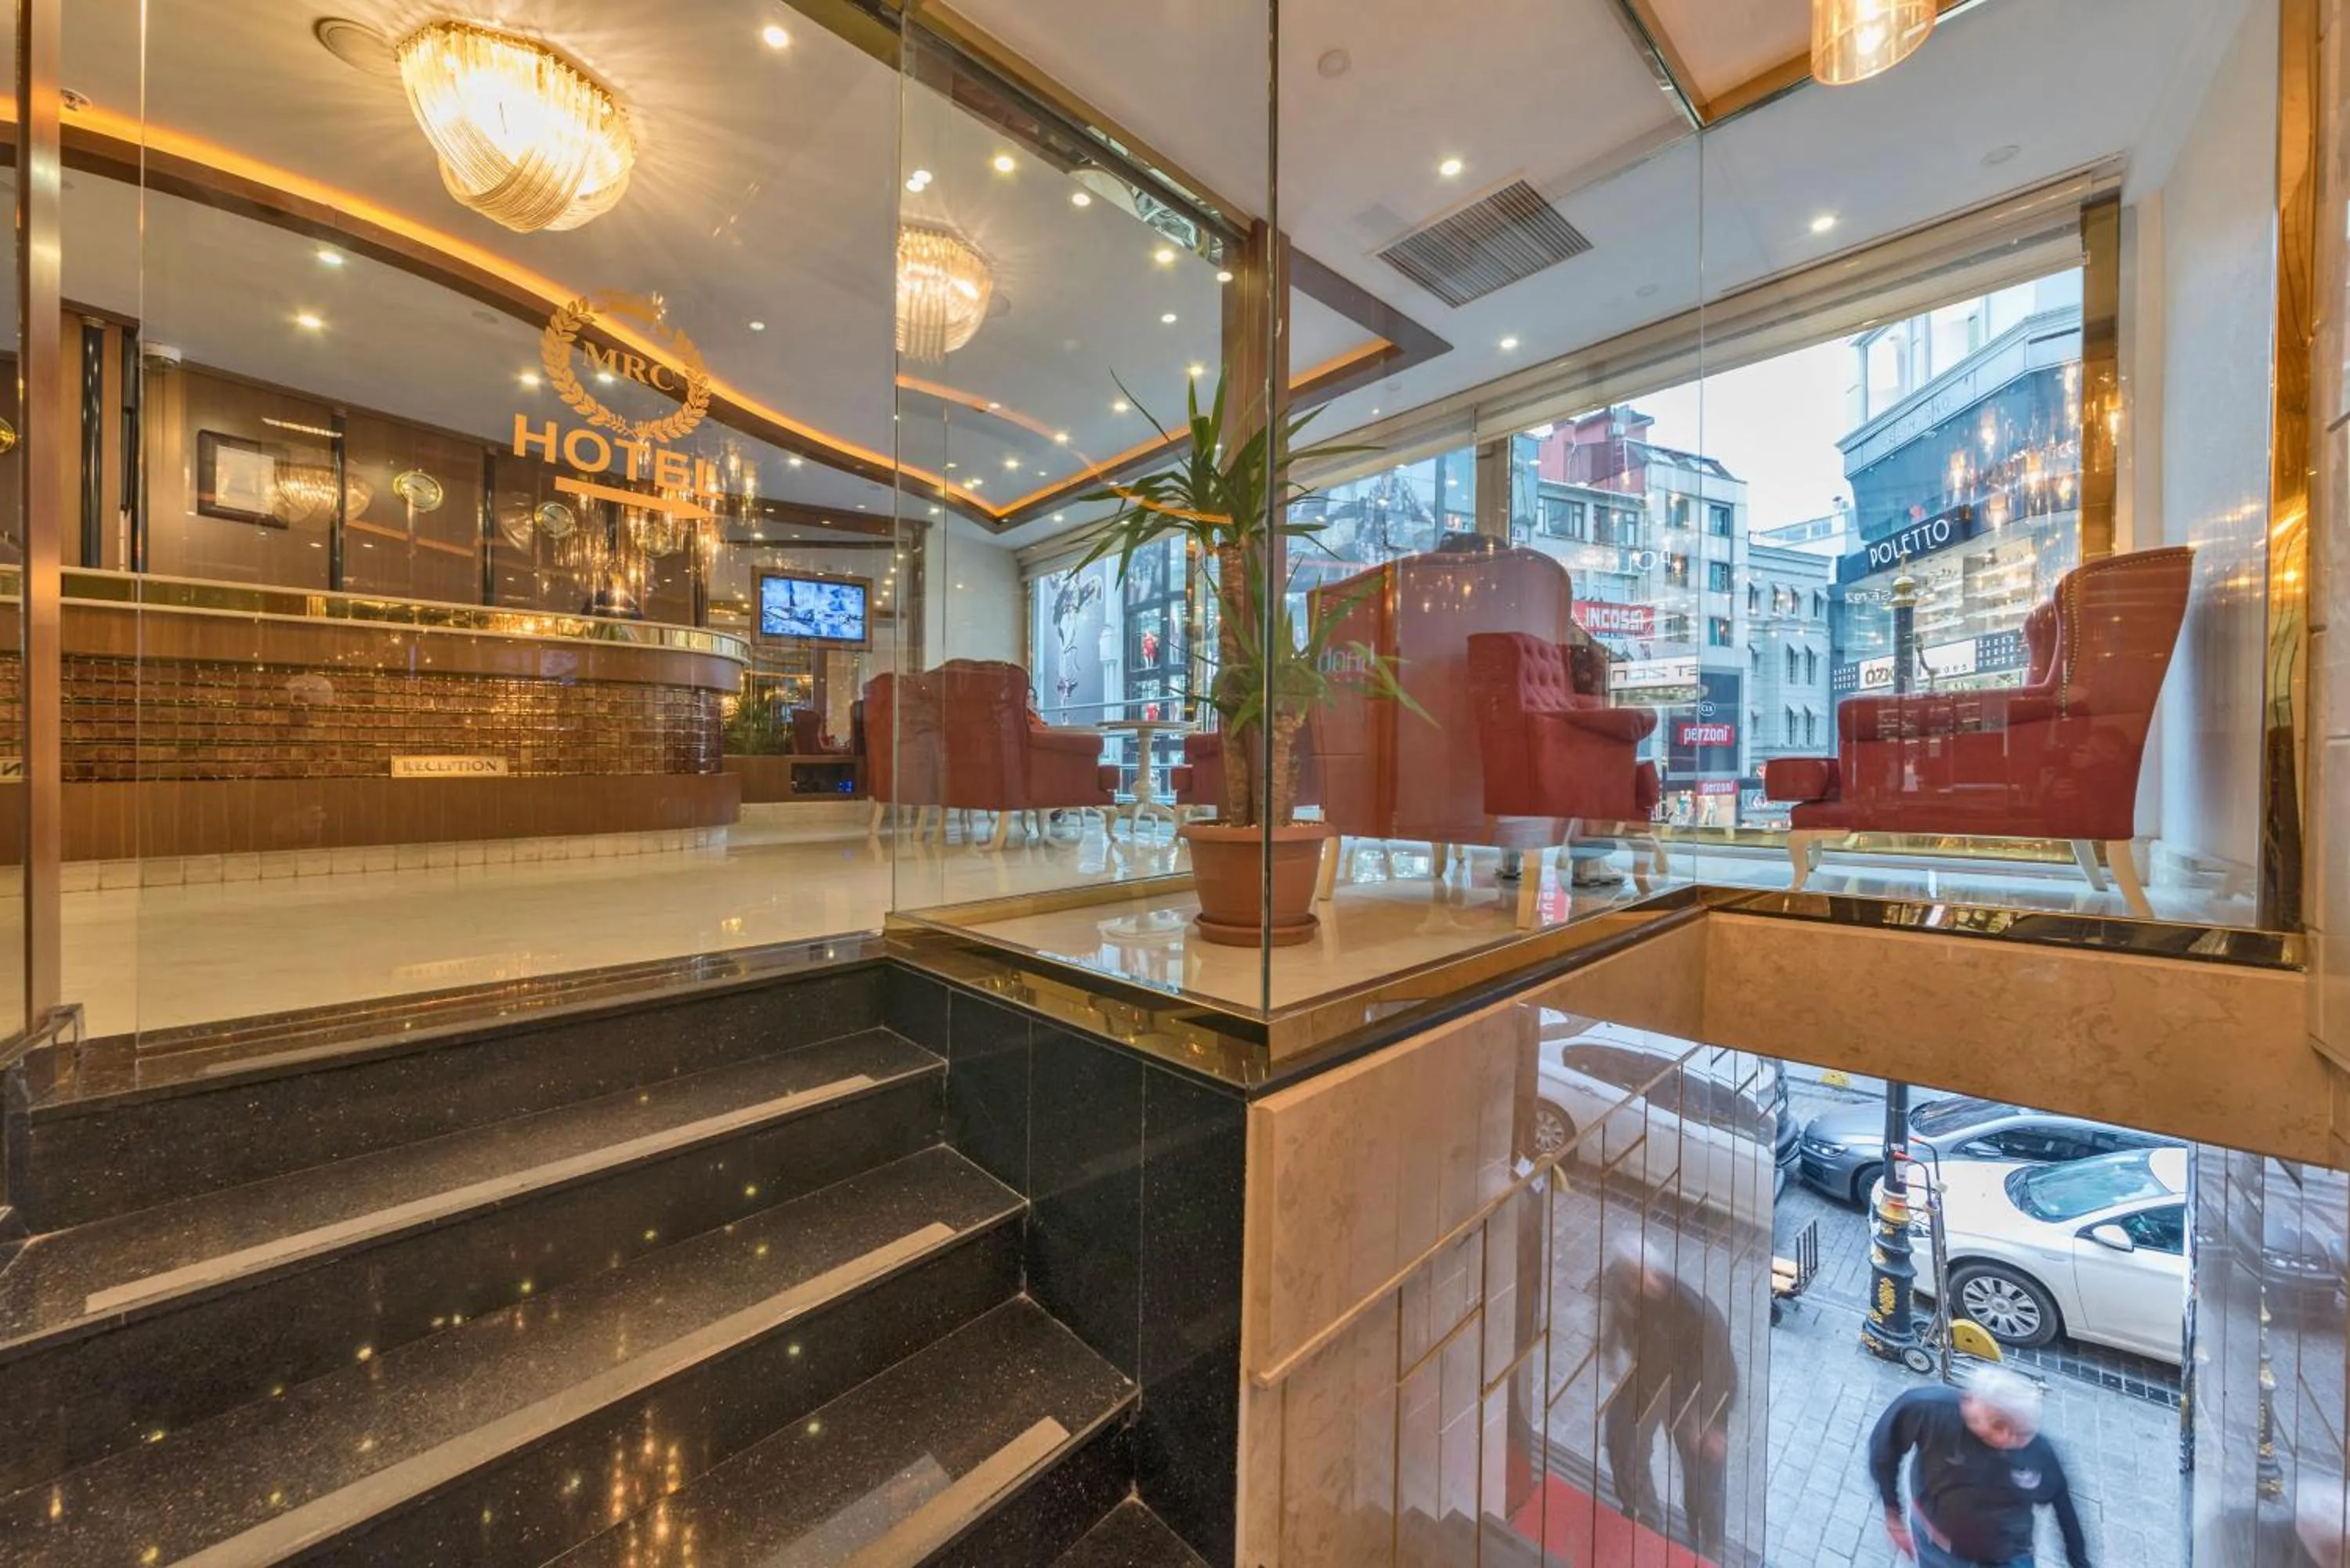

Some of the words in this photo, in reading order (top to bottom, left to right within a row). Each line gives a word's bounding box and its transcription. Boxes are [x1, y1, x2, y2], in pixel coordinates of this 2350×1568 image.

[580, 340, 675, 391] MRC
[513, 413, 725, 500] HOTEL
[1869, 518, 1950, 568] POLETTO
[1683, 725, 1728, 745] perzoni
[403, 760, 497, 772] RECEPTION
